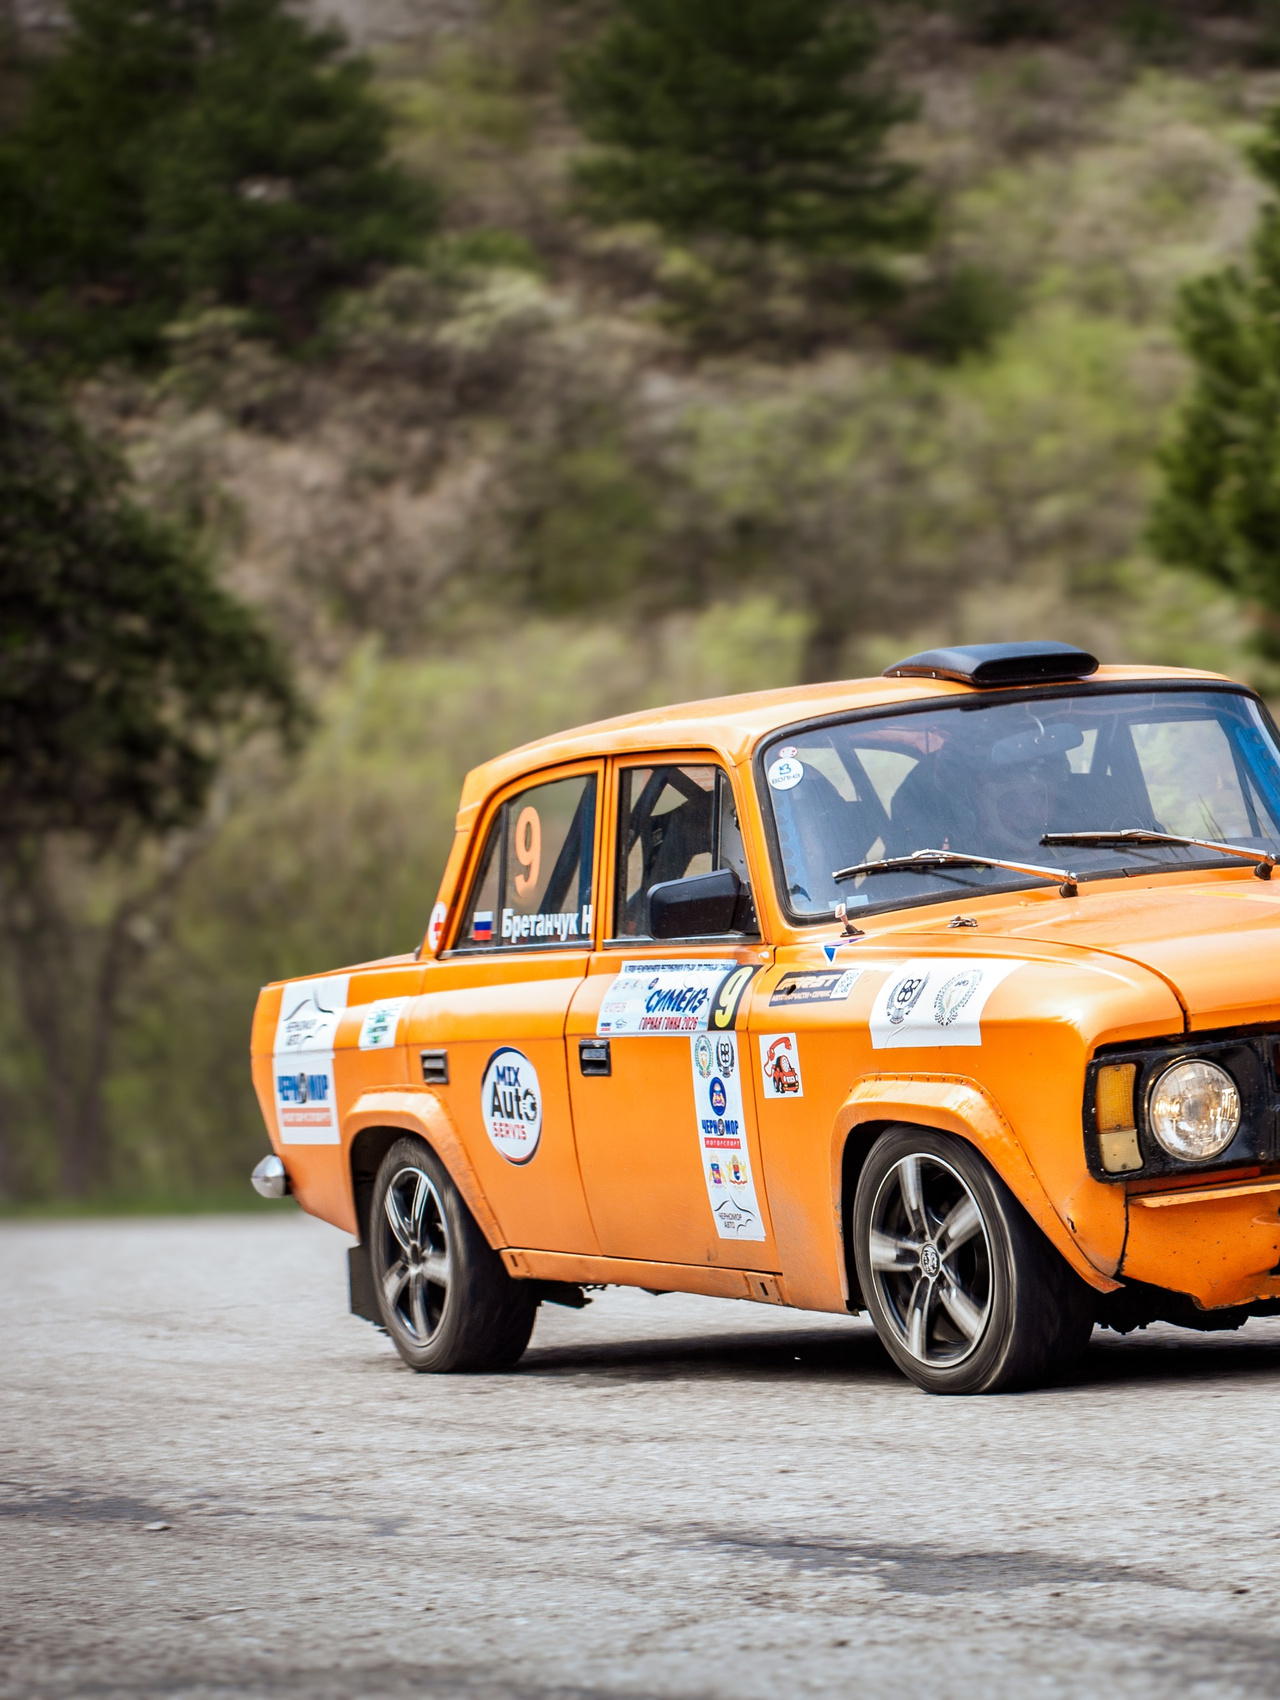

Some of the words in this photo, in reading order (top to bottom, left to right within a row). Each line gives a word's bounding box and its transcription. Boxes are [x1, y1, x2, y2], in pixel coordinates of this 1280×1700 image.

[514, 806, 541, 899] 9
[501, 908, 580, 943] Бретанчук
[645, 987, 708, 1013] СИМЕИЗ
[714, 966, 754, 1028] 9
[638, 1017, 663, 1031] ГОРНАЯ
[662, 1017, 681, 1031] ГОНКА
[681, 1017, 699, 1030] 2026
[496, 1065, 521, 1088] MIX
[493, 1121, 527, 1140] SERVIS
